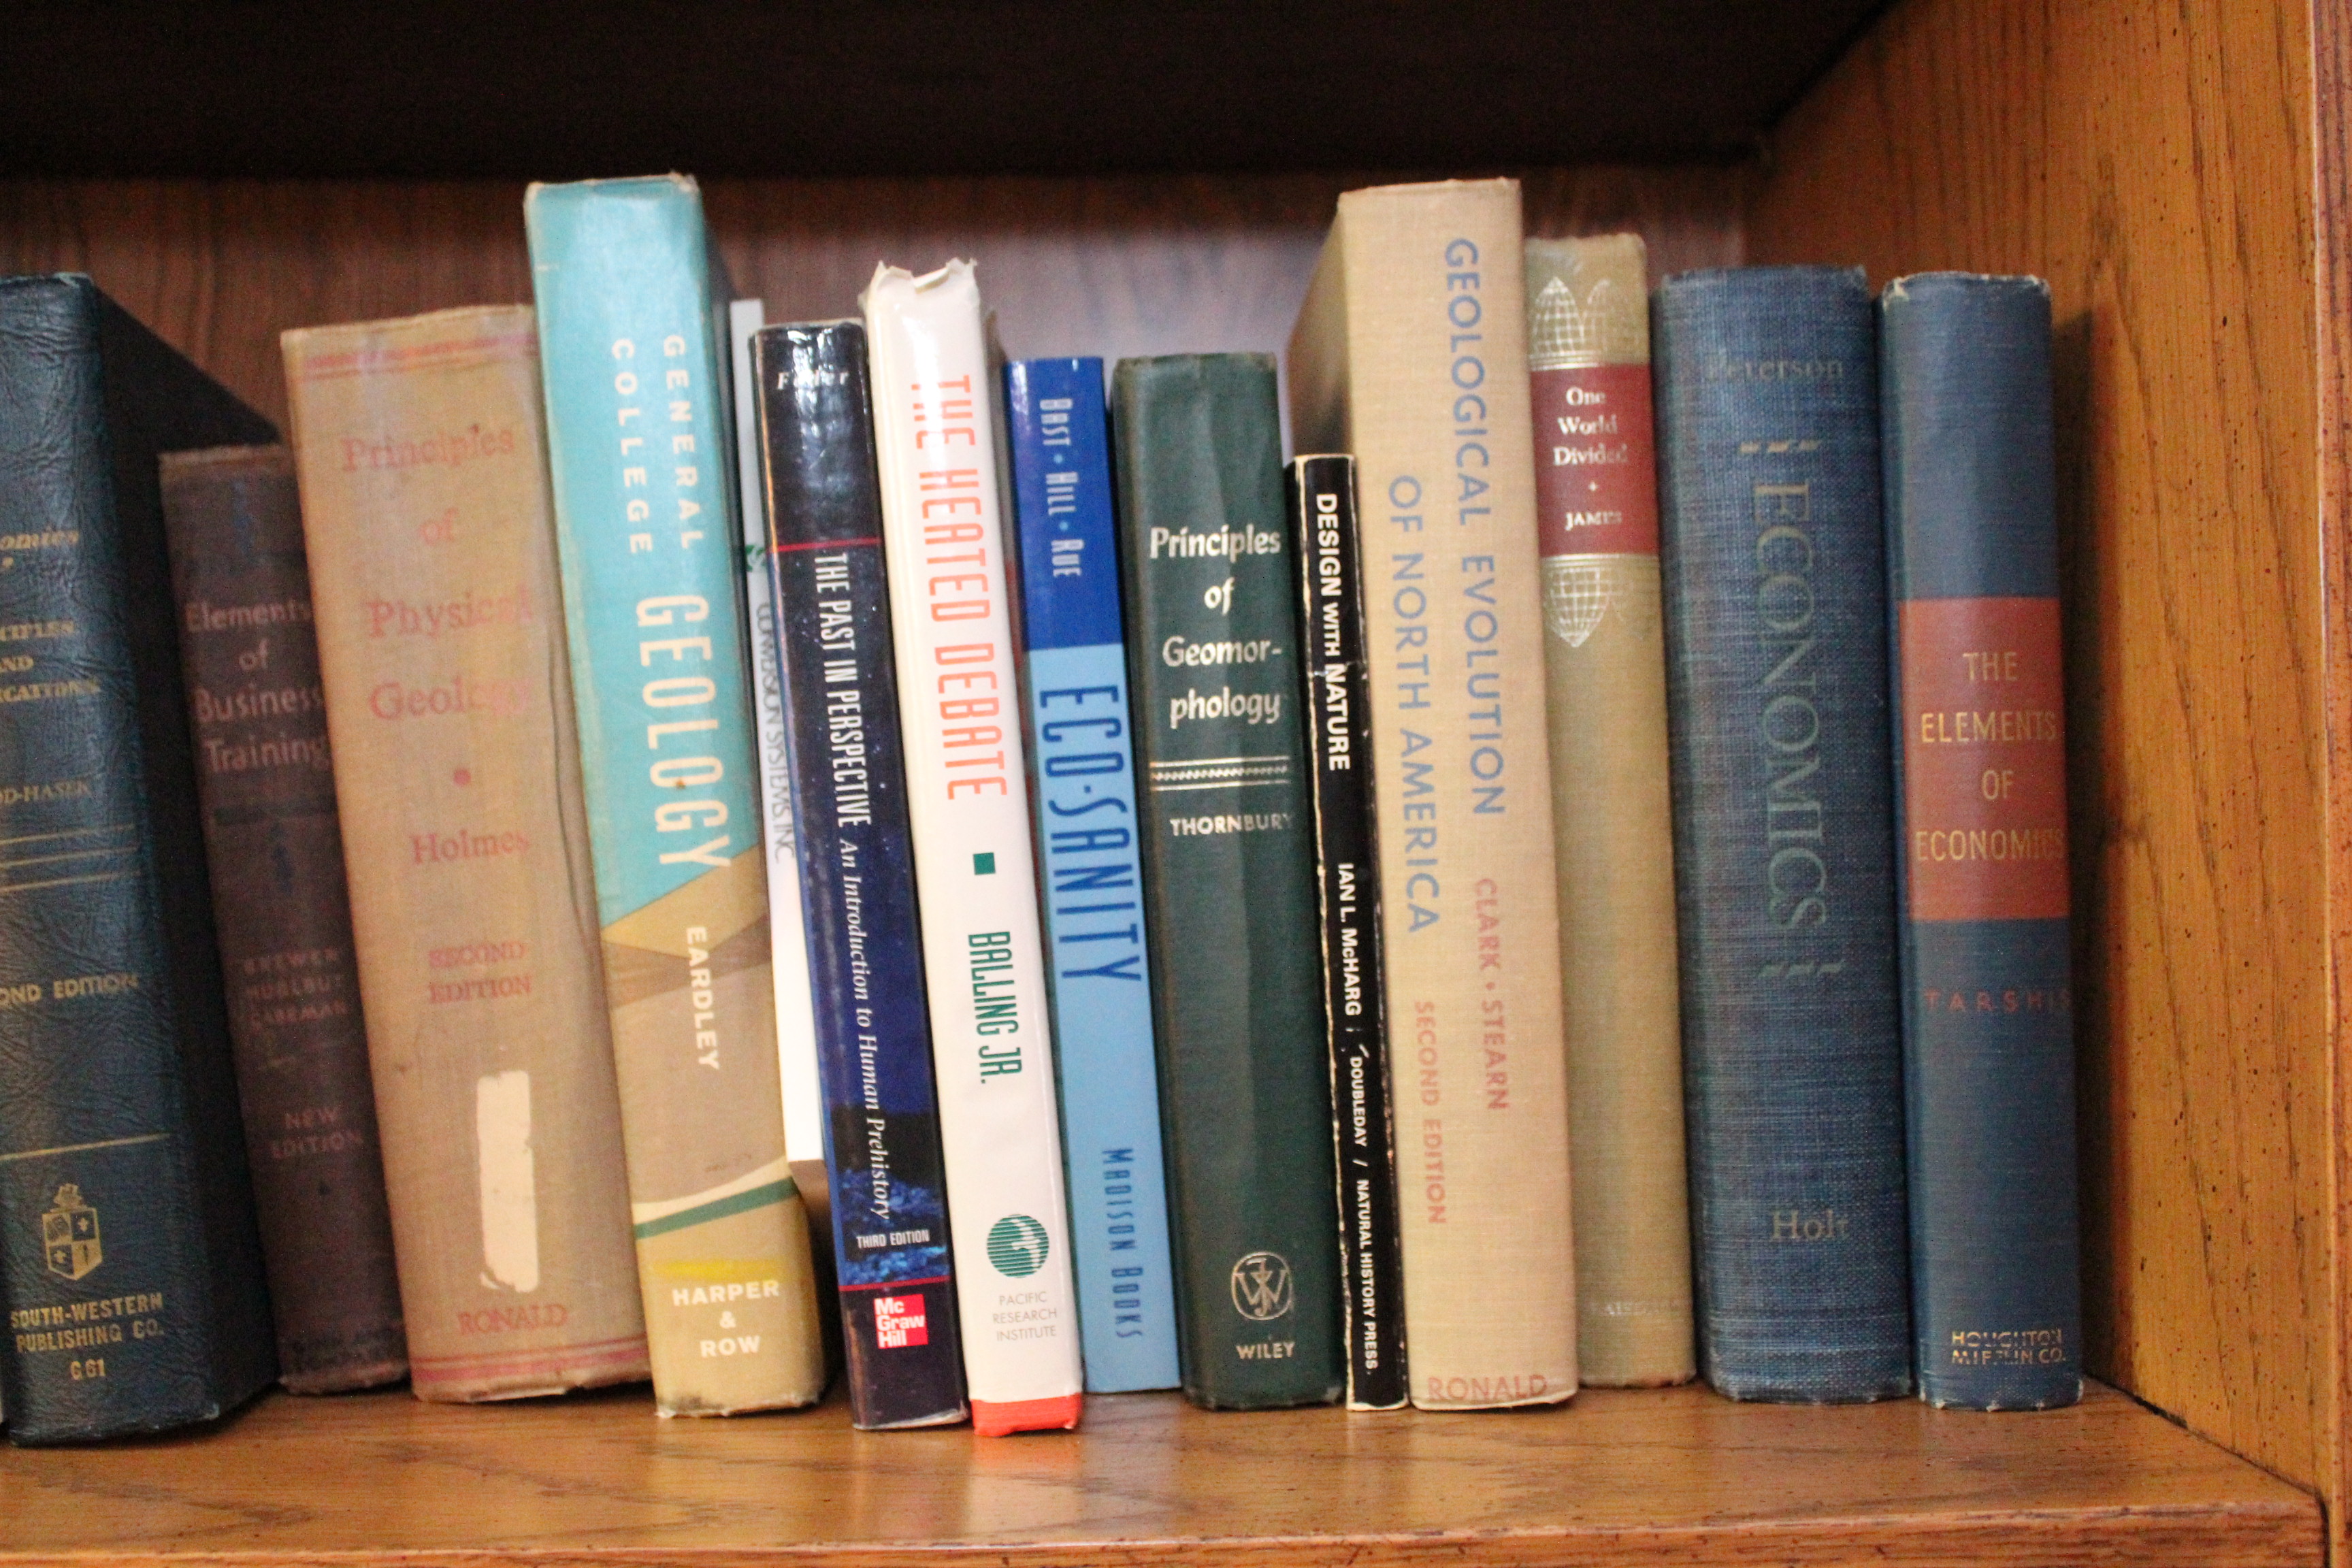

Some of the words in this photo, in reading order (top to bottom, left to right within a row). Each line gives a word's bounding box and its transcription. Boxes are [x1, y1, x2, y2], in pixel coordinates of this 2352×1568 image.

[1444, 238, 1491, 527] GEOLOGICAL
[1565, 386, 1606, 406] One
[911, 375, 976, 450] THE
[1039, 397, 1073, 447] BAST
[1556, 413, 1618, 436] World
[342, 423, 514, 472] Principles
[611, 338, 652, 554] COLLEGE
[664, 333, 704, 549] GENERAL
[1552, 441, 1629, 467] Divided
[1045, 471, 1079, 517] HILL
[1388, 474, 1424, 533] OF
[419, 506, 459, 545] of
[1564, 509, 1624, 534] JAMES
[919, 468, 991, 622] HEATED
[1051, 538, 1085, 578] RUE
[1149, 523, 1281, 564] Principles
[1316, 493, 1342, 596] DESIGN
[815, 553, 851, 593] THE
[185, 599, 313, 632] Elements
[366, 583, 534, 640] Physical
[1203, 576, 1235, 616] of
[819, 600, 855, 651] PAST
[1322, 602, 1341, 656] WITH
[1391, 552, 1431, 710] NORTH
[239, 638, 267, 671] of
[823, 659, 858, 684] IN
[1162, 635, 1283, 668] Geomor-
[1963, 651, 2018, 681] THE
[195, 683, 323, 723] Business
[1461, 554, 1506, 815] EVOLUTION
[934, 642, 1007, 800] DEBATE
[1170, 686, 1281, 730] phology
[1324, 663, 1351, 771] NATURE
[1752, 480, 1827, 930] ECONOMICS
[636, 595, 732, 868] GEOLOGY
[1921, 710, 2058, 743] ELEMENTS
[826, 690, 872, 828] PERSPECTIVE
[1980, 769, 2014, 800] OF
[1169, 813, 1292, 836] THORNBURY
[1399, 728, 1440, 934] AMERICA
[411, 829, 529, 865] Holmes
[839, 838, 860, 868] An
[1914, 828, 2065, 862] ECONOMICS
[1337, 862, 1356, 901] IAN
[1339, 907, 1356, 922] L.
[1474, 877, 1501, 971] CLARK
[843, 875, 872, 1000] Introduction
[53, 972, 138, 999] EDITION
[428, 973, 533, 1004] EDITION
[968, 930, 1019, 1036] BALLING
[1341, 928, 1362, 1017] McHARG
[685, 926, 720, 1071] EARDLEY
[856, 1007, 873, 1028] to
[858, 1033, 880, 1110] Human
[977, 1045, 1023, 1084] JR.
[1414, 1000, 1440, 1107] SECOND
[1481, 1000, 1510, 1111] STEARN
[1350, 1056, 1368, 1147] DOUBLEDAY
[866, 1117, 890, 1220] Prehistory
[1422, 1118, 1447, 1224] EDITION
[1101, 1148, 1137, 1251] MADISON
[1356, 1179, 1373, 1250] NATURAL
[856, 1232, 887, 1249] THIRD
[889, 1228, 930, 1246] EDITION
[1771, 1209, 1850, 1241] Holt
[672, 1279, 780, 1307] HARPER
[875, 1297, 904, 1314] Mc
[998, 1290, 1047, 1306] PACIFIC
[1111, 1267, 1144, 1338] BOOKS
[1360, 1253, 1377, 1318] HISTORY
[10, 1293, 163, 1328] SOUTH-WESTERN
[457, 1303, 568, 1336] RONALD
[719, 1310, 737, 1330] &
[876, 1313, 926, 1331] Graw
[992, 1308, 1058, 1324] RESEARCH
[16, 1324, 122, 1353] PUBLISHING
[133, 1318, 165, 1339] CO.
[699, 1335, 761, 1358] ROW
[877, 1330, 907, 1349] Hill
[996, 1325, 1058, 1342] INSTITUTE
[1236, 1341, 1295, 1360] WILEY
[1363, 1321, 1378, 1370] PRESS
[1952, 1328, 2063, 1348] HOUGHTON
[1428, 1375, 1548, 1401] RONALD
